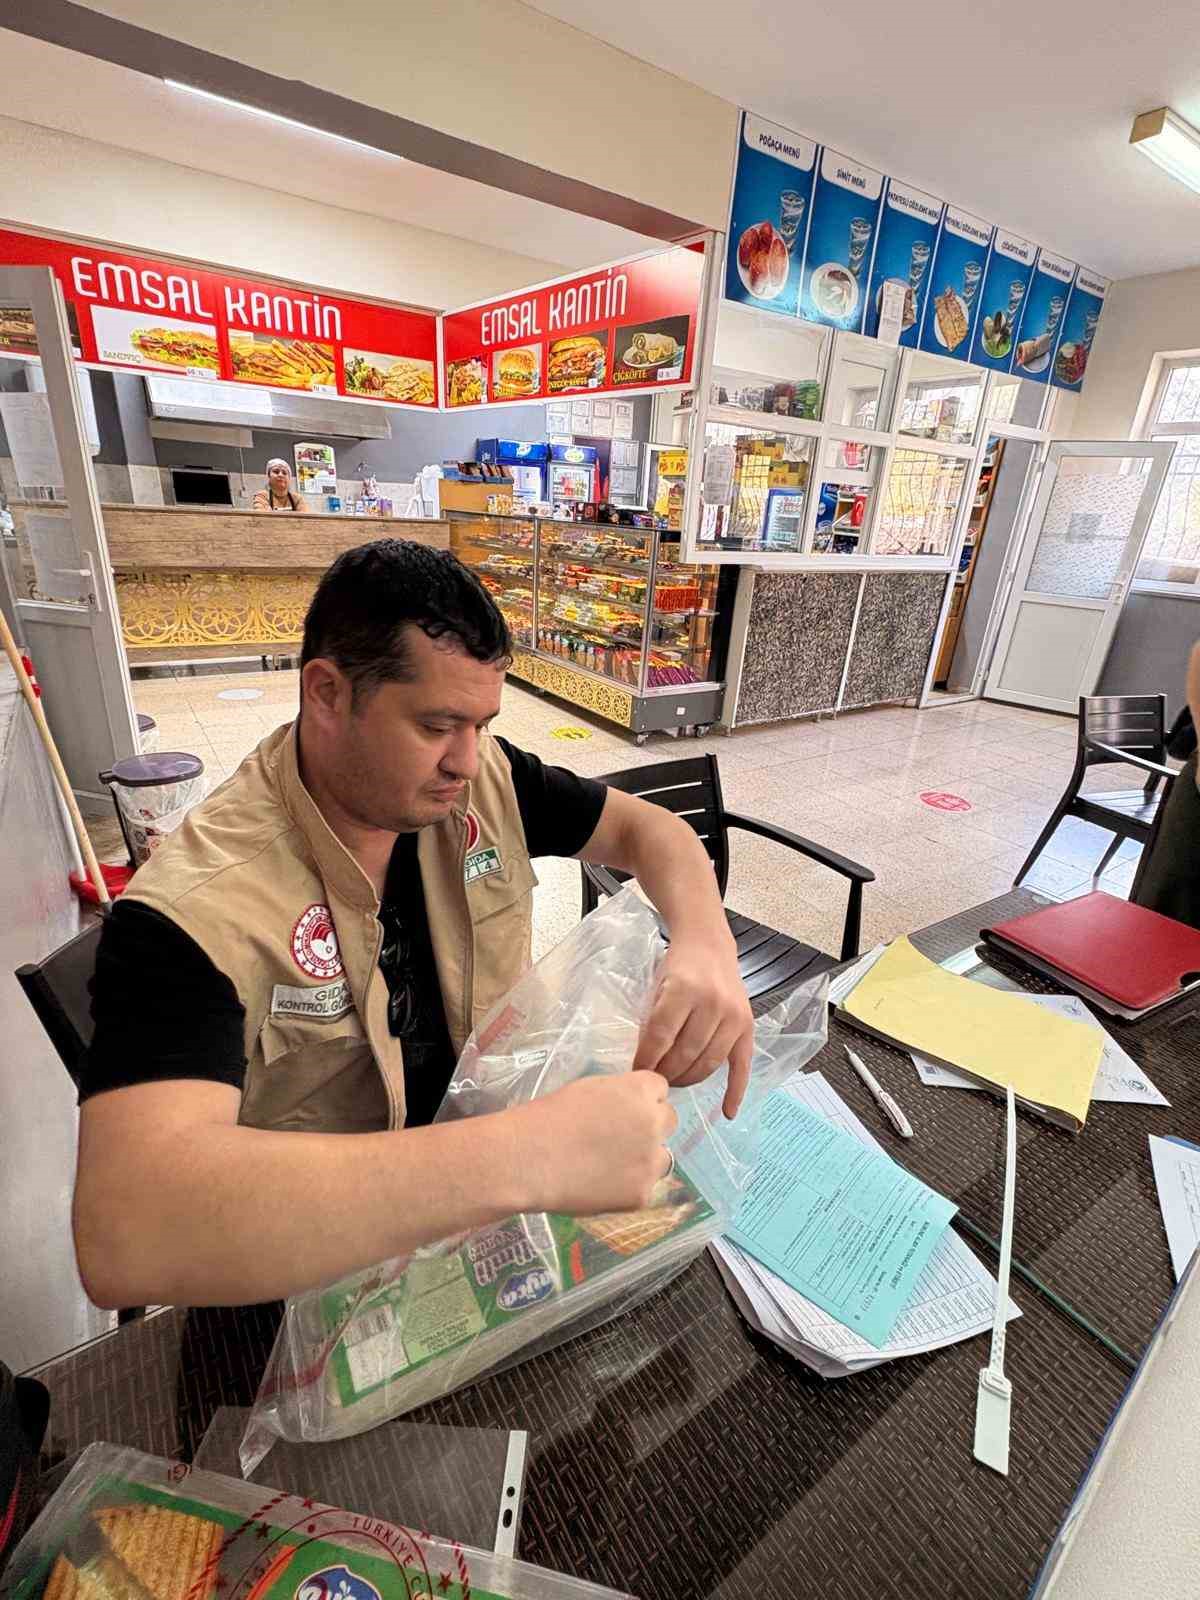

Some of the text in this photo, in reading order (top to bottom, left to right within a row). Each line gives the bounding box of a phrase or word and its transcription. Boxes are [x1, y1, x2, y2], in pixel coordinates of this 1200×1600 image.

[759, 133, 800, 159] POĞAÇA MENÜ
[851, 174, 866, 188] MENÜ
[71, 257, 343, 341] EMSAL KANTİN
[481, 268, 628, 346] EMSAL KANTİN
[277, 999, 328, 1013] KONTROL
[352, 1515, 414, 1569] TÜRKİYE
